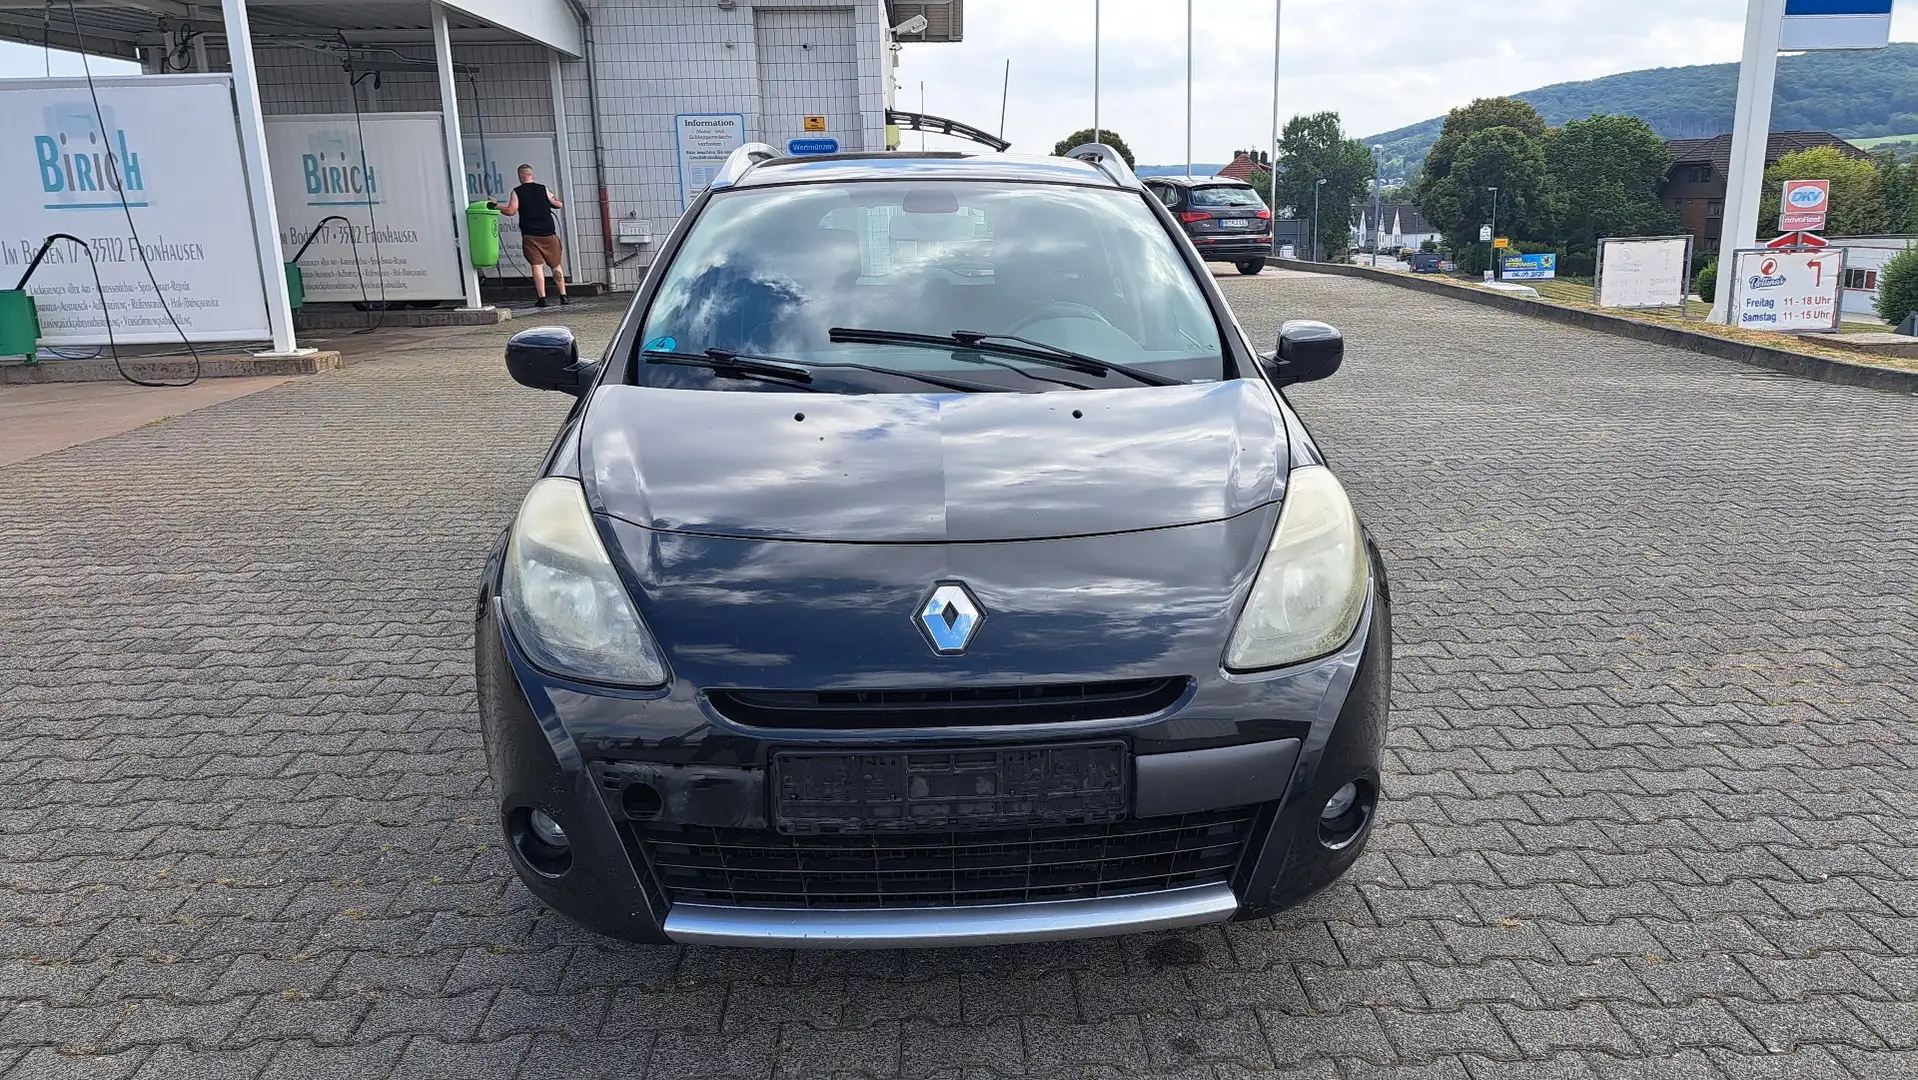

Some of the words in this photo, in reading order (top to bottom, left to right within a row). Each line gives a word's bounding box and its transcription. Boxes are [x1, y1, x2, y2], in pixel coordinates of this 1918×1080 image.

[684, 119, 734, 127] Information
[792, 143, 835, 151] Wertmünzen
[467, 161, 504, 194] rich
[1790, 191, 1822, 202] DKV
[1, 240, 19, 265] Im
[90, 237, 126, 263] 35112
[128, 234, 205, 262] Fronhausen
[1749, 274, 1787, 289] Bettina's
[1746, 298, 1775, 309] Freitag
[1783, 298, 1793, 306] 11
[1801, 297, 1812, 305] 18
[1815, 296, 1832, 305] Uhr
[1742, 312, 1777, 323] Samstag
[1782, 312, 1793, 320] 11
[1801, 311, 1812, 319] 15
[1813, 310, 1831, 319] Uhr
[656, 337, 666, 348] 4
